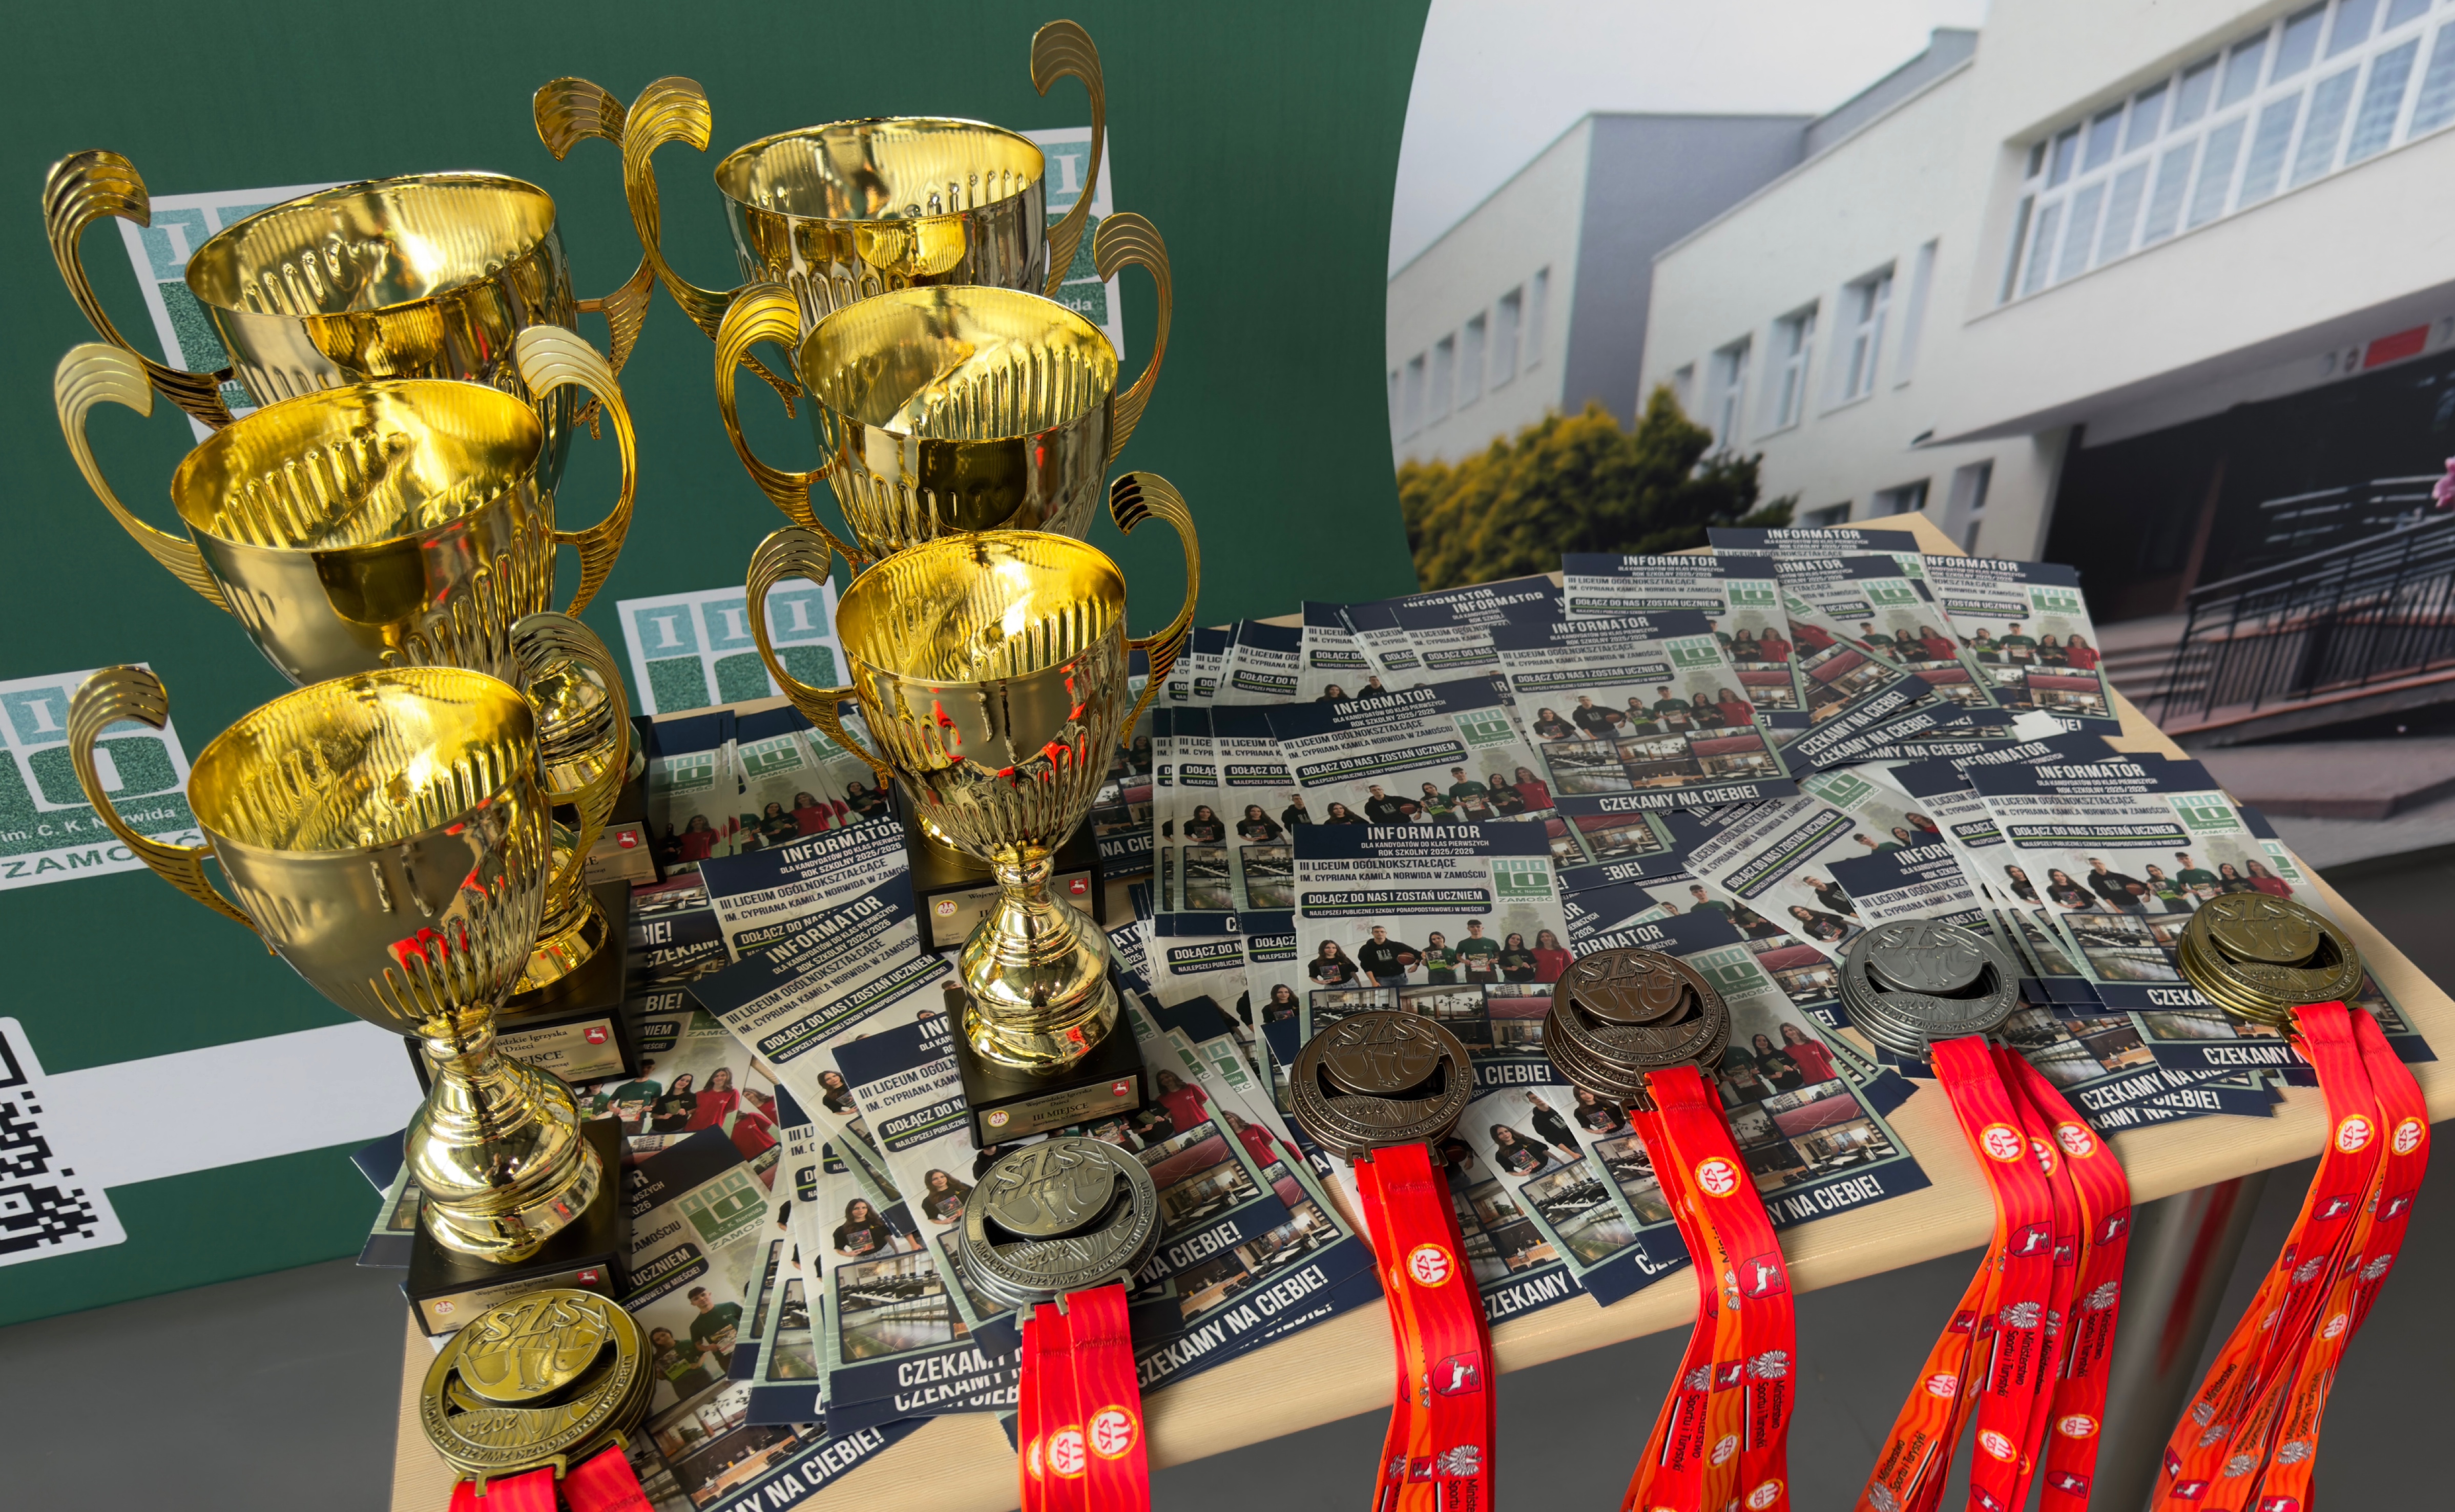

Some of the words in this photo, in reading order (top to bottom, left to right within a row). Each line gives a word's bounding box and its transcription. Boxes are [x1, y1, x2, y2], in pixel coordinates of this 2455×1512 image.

[1767, 529, 1861, 539] INFORMATOR
[1623, 556, 1717, 566] INFORMATOR
[1982, 601, 2022, 611] UCZNIEM
[1552, 616, 1650, 634] INFORMATOR
[1517, 674, 1553, 684] DOŁĄCZ
[1590, 668, 1625, 678] ZOSTAŃ
[1625, 664, 1665, 676] UCZNIEM
[1334, 688, 1436, 716] INFORMATOR
[1348, 720, 1365, 728] ROK
[1364, 715, 1396, 726] SZKOLNY
[1396, 708, 1436, 720] 2025/2026
[1797, 723, 1853, 755] CZEKAMY
[1850, 712, 1866, 728] NA
[1863, 690, 1909, 719] CIEBIE!
[1866, 731, 1888, 745] NA
[1887, 713, 1937, 738] CIEBIE!
[1284, 742, 1295, 750] III
[1294, 736, 1330, 749] LICEUM
[1329, 718, 1425, 744] OGÓLNOKSZTAŁCĄCE
[1287, 751, 1301, 759] IM.
[1300, 745, 1340, 757] CYPRIANA
[1339, 741, 1370, 751] KAMILA
[1369, 735, 1407, 747] NORWIDA
[1414, 724, 1453, 740] ZAMOŚCIU
[1302, 763, 1340, 777] DOŁĄCZ
[1338, 761, 1353, 770] DO
[1353, 758, 1374, 768] NAS
[1378, 750, 1416, 764] ZOSTAŃ
[1415, 743, 1457, 758] UCZNIEM
[2035, 764, 2146, 779] INFORMATOR
[1599, 790, 1675, 811] CZEKAMY
[1677, 788, 1701, 805] NA
[1702, 785, 1760, 803] CIEBIE!
[1, 830, 32, 843] im.
[38, 824, 59, 837] C.
[65, 820, 86, 833] K.
[92, 808, 175, 829] Nrwida
[1367, 825, 1481, 840] INFORMATOR
[2013, 826, 2053, 837] DOŁĄCZ
[2051, 826, 2067, 835] DO
[2066, 826, 2089, 834] NAS
[2087, 826, 2094, 834] I
[2092, 825, 2133, 834] ZOSTAŃ
[2131, 825, 2177, 834] UCZNIEM
[1, 831, 201, 879] ZAMOĆ
[781, 822, 904, 864] INFORMATOR
[1375, 841, 1419, 849] KANDYDATÓW
[800, 866, 819, 877] ROK
[819, 855, 856, 872] SZKOLNY
[856, 842, 902, 862] 2025/2026
[1299, 862, 1310, 871] III
[1312, 860, 1350, 871] LICEUM
[1353, 857, 1457, 871] OGÓLNOKSZTAŁCĄCE
[720, 898, 733, 910] III
[733, 888, 777, 907] LICEUM
[776, 856, 888, 898] OGÓLNOKSZTAŁCĄCE
[1315, 873, 1357, 882] CYPRIANA
[1359, 873, 1391, 881] KAMILA
[1393, 872, 1432, 880] NORWIDA
[1444, 870, 1487, 879] ZAMOŚCIU
[1308, 894, 1348, 905] DOŁĄCZ
[1350, 894, 1364, 903] DO
[1366, 893, 1387, 902] NAS
[1390, 893, 1393, 902] I
[1396, 891, 1434, 902] ZOSTAŃ
[1437, 891, 1483, 901] UCZNIEM
[766, 897, 884, 964] INFORMATOR
[792, 959, 814, 973] ROK
[810, 942, 850, 964] SZKOLNY
[847, 919, 894, 947] 2025/2026
[726, 1012, 741, 1024] III
[738, 991, 780, 1018] LICEUM
[775, 937, 887, 998] OGÓLNOKSZTAŁCĄCE
[886, 955, 936, 983] UCZNIEM
[1578, 952, 1655, 983] SZS
[841, 998, 850, 1007] I
[845, 976, 890, 1004] ZOSTAŃ
[803, 1013, 823, 1028] DO
[818, 1000, 845, 1019] NAS
[529, 1030, 568, 1042] Igrzyska
[764, 1021, 809, 1051] DOŁĄCZ
[1336, 1015, 1418, 1047] SZS
[505, 1043, 534, 1053] Dzieci
[2203, 1046, 2291, 1065] CZEKAMY
[859, 1086, 872, 1099] III
[873, 1071, 919, 1095] LICEUM
[1487, 1065, 1551, 1085] CIEBIE!
[865, 1101, 883, 1112] IM.
[883, 1083, 933, 1106] CYPRIANA
[2079, 1072, 2164, 1111] CZEKAMY
[886, 1109, 934, 1135] DOŁĄCZ
[934, 1103, 951, 1118] DO
[1047, 1102, 1089, 1119] MIEJSCE
[995, 1139, 1084, 1194] SZS
[1787, 1195, 1816, 1219] NA
[1819, 1174, 1884, 1211] CIEBIE!
[1171, 1221, 1243, 1269] CIEBIE!
[1227, 1303, 1259, 1334] NA
[1254, 1265, 1329, 1317] CIEBIE!
[482, 1294, 588, 1342] SZS
[2004, 1330, 2019, 1358] Sportu
[2015, 1332, 2035, 1385] Ministerstwo
[1996, 1362, 2014, 1398] Turystyki
[763, 1474, 805, 1508] NA
[801, 1426, 885, 1485] CIEBIE!
